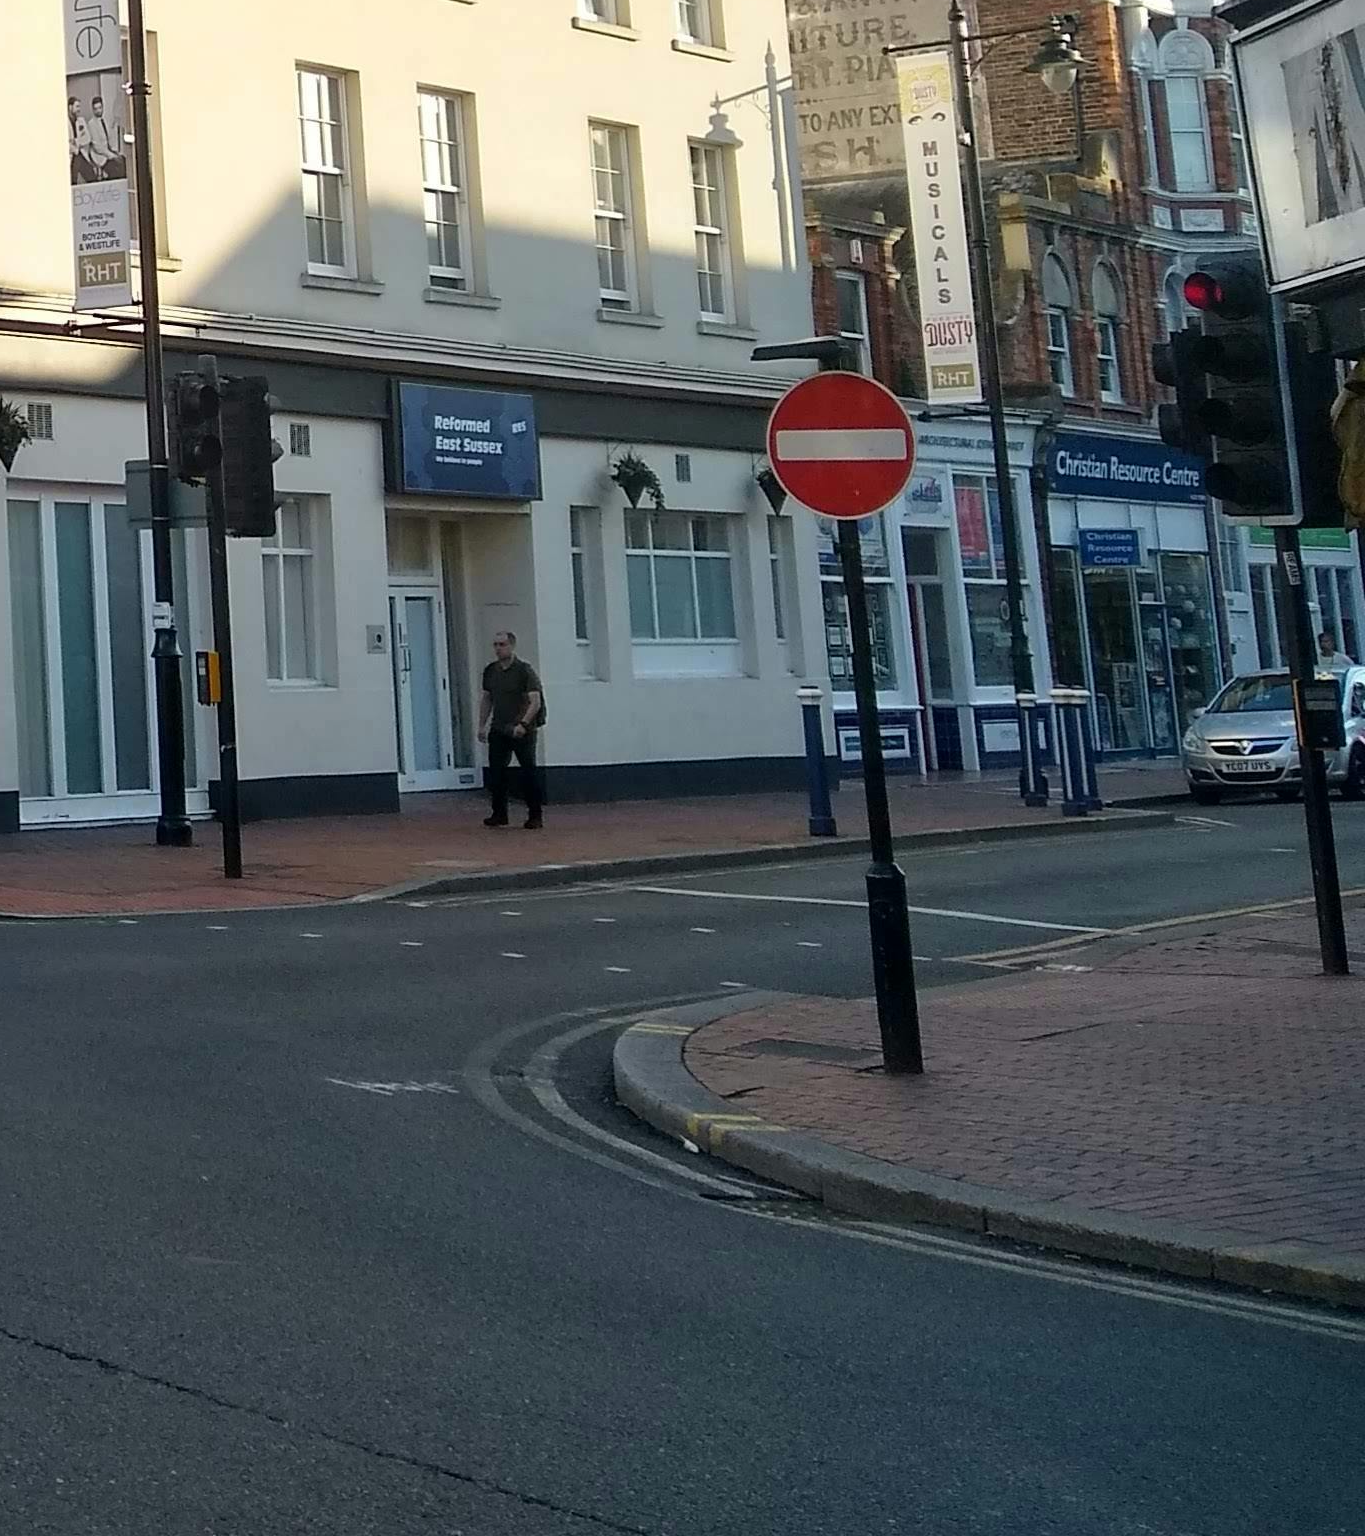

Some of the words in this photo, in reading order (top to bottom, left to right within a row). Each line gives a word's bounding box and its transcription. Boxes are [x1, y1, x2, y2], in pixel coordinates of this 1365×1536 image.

[798, 114, 822, 134] TO
[827, 108, 863, 131] ANY
[81, 213, 103, 221] PLAYING
[922, 140, 951, 304] MUSICALS
[82, 230, 116, 241] BOYZONE
[79, 243, 84, 251] &
[85, 239, 121, 250] WESTLIFE
[84, 262, 121, 282] RHT
[924, 319, 973, 347] DUSTY
[938, 371, 971, 386] RHT
[434, 415, 491, 433] Reformed
[435, 435, 461, 451] East
[463, 438, 503, 455] Sussex
[1056, 450, 1108, 479] Christian
[1110, 455, 1161, 484] Resource
[1162, 461, 1200, 487] Centre
[1086, 532, 1132, 541] Christian
[1087, 544, 1134, 553] Resource
[1093, 555, 1129, 564] Centre
